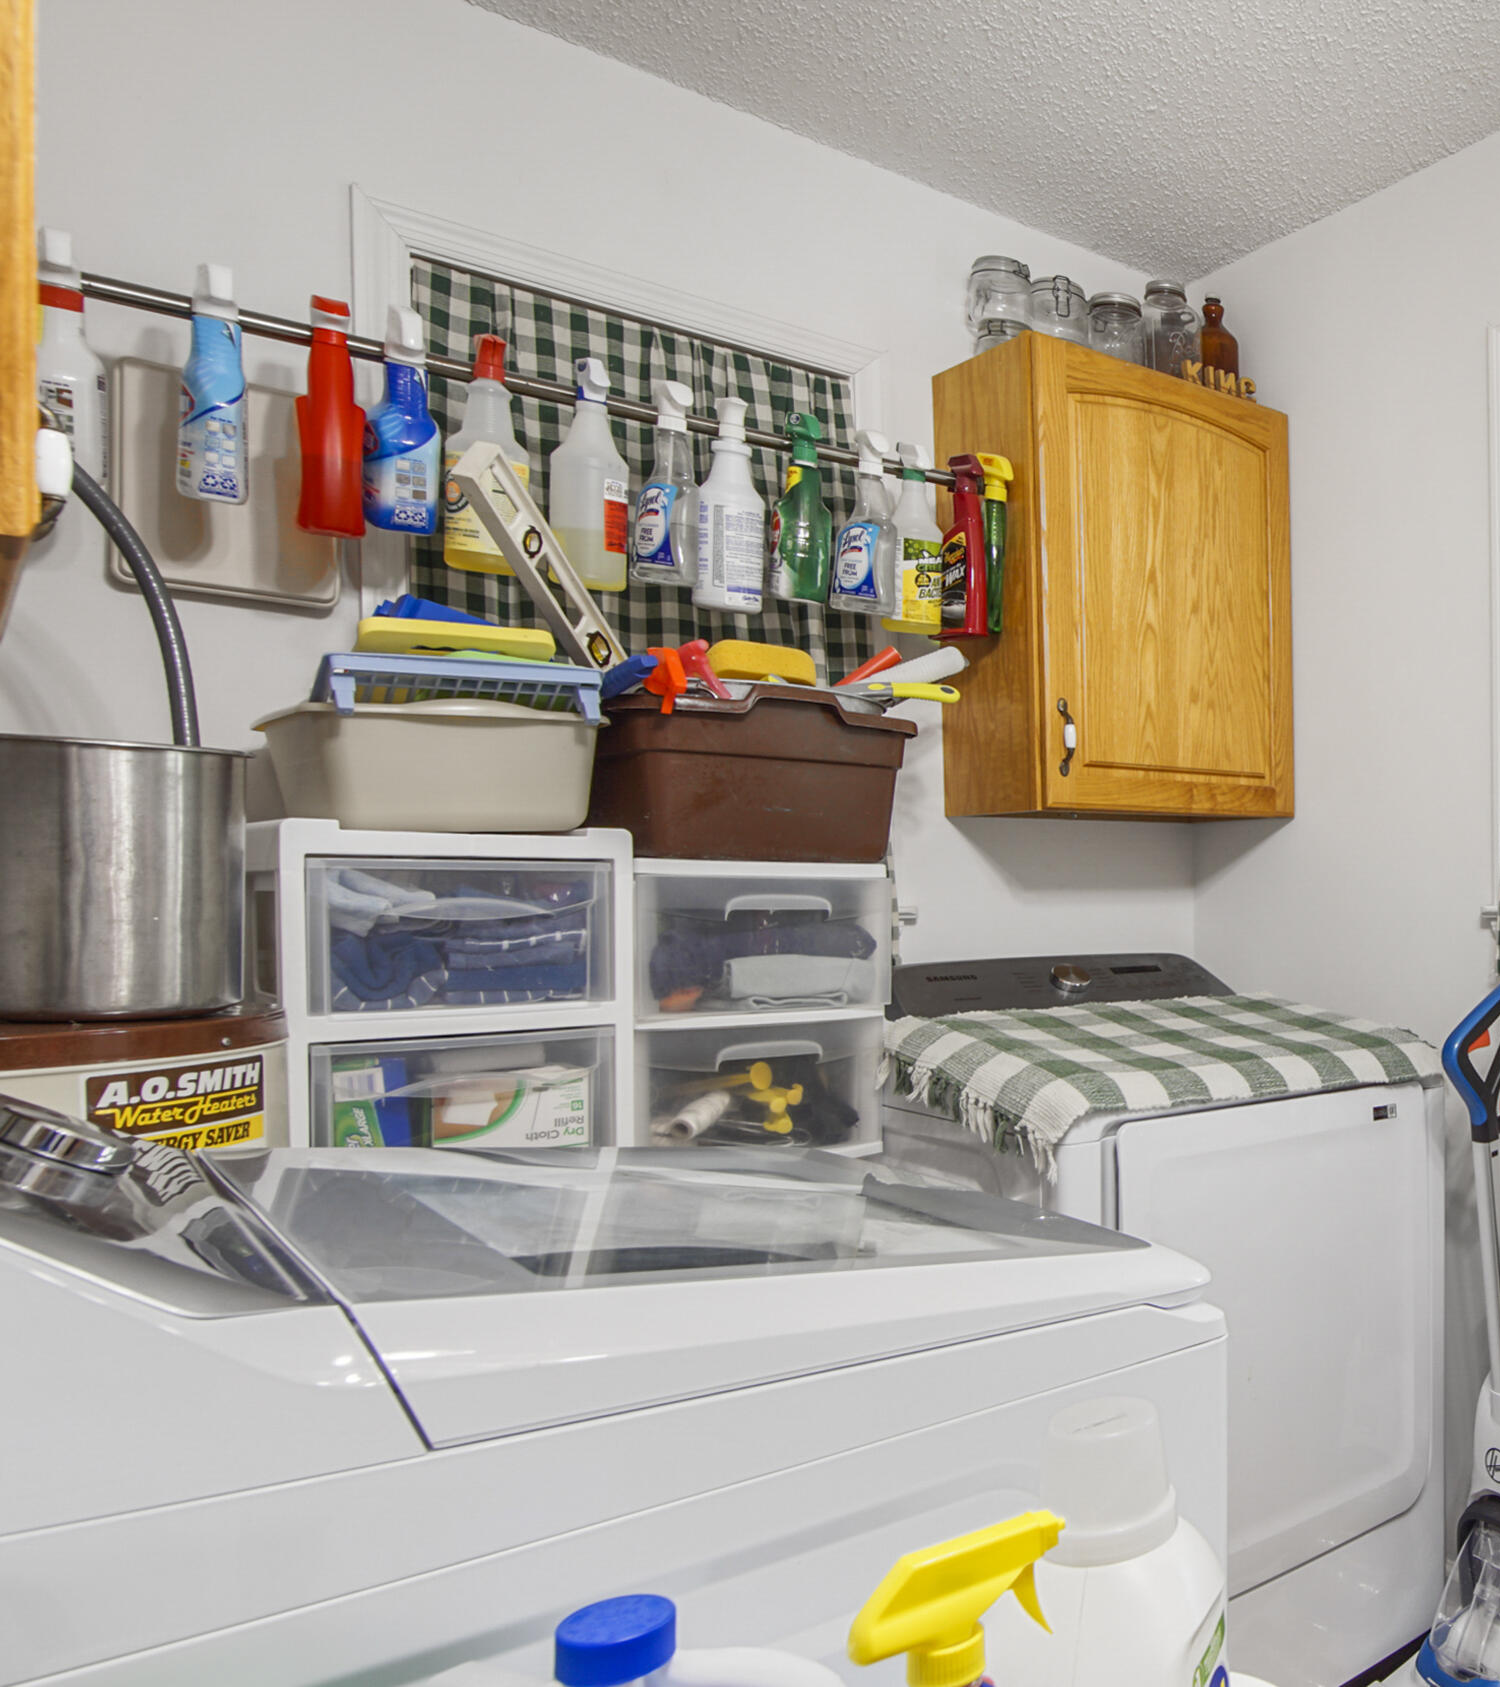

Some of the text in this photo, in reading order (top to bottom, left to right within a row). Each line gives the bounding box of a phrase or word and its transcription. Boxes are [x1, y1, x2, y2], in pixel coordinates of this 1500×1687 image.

[925, 974, 978, 983] SAMSUNG
[95, 1086, 258, 1129] Water Heaters
[554, 1115, 585, 1128] Refill
[204, 1121, 251, 1147] SAVER
[525, 1126, 585, 1141] Dry Cloth
